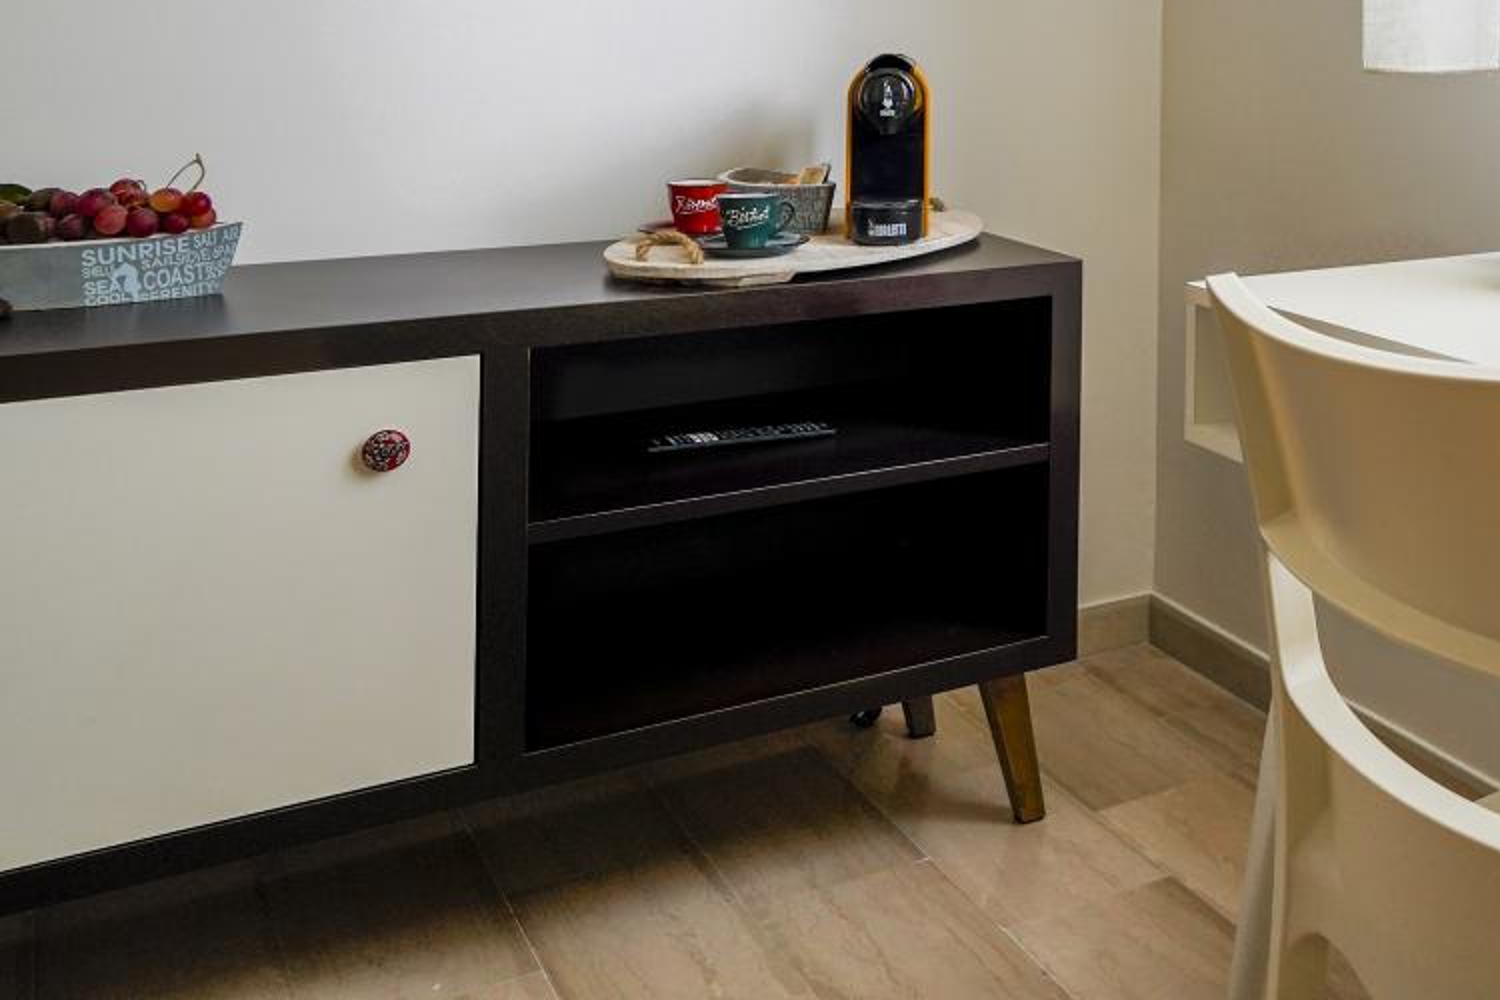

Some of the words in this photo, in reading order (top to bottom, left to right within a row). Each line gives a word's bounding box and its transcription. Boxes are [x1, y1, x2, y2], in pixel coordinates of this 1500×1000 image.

[81, 237, 190, 267] SUNRISE
[82, 279, 120, 297] SEA
[143, 263, 207, 292] COAST
